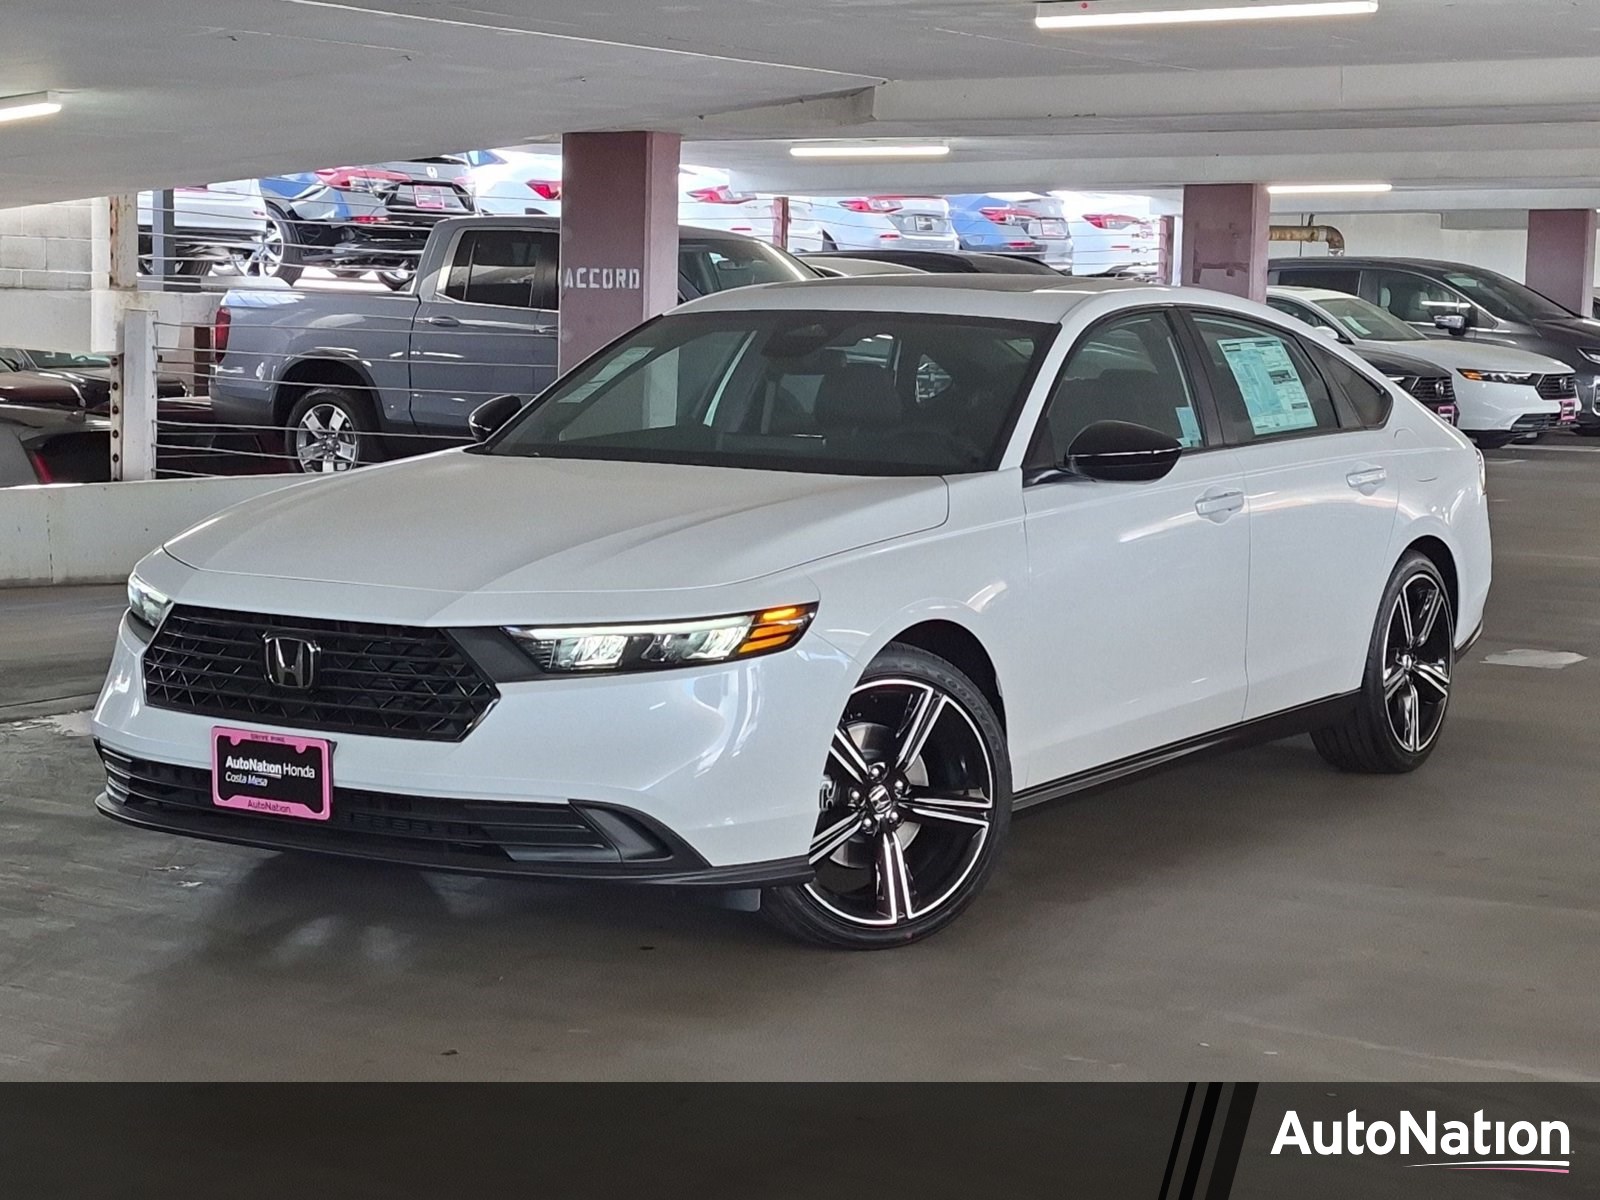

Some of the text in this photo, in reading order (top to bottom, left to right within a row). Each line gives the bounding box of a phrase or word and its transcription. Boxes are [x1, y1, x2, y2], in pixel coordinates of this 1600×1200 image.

[564, 267, 640, 289] ACCORD
[225, 755, 316, 779] AutoNation Honda
[225, 771, 268, 787] Costa Mesa
[247, 799, 292, 813] AutoNation
